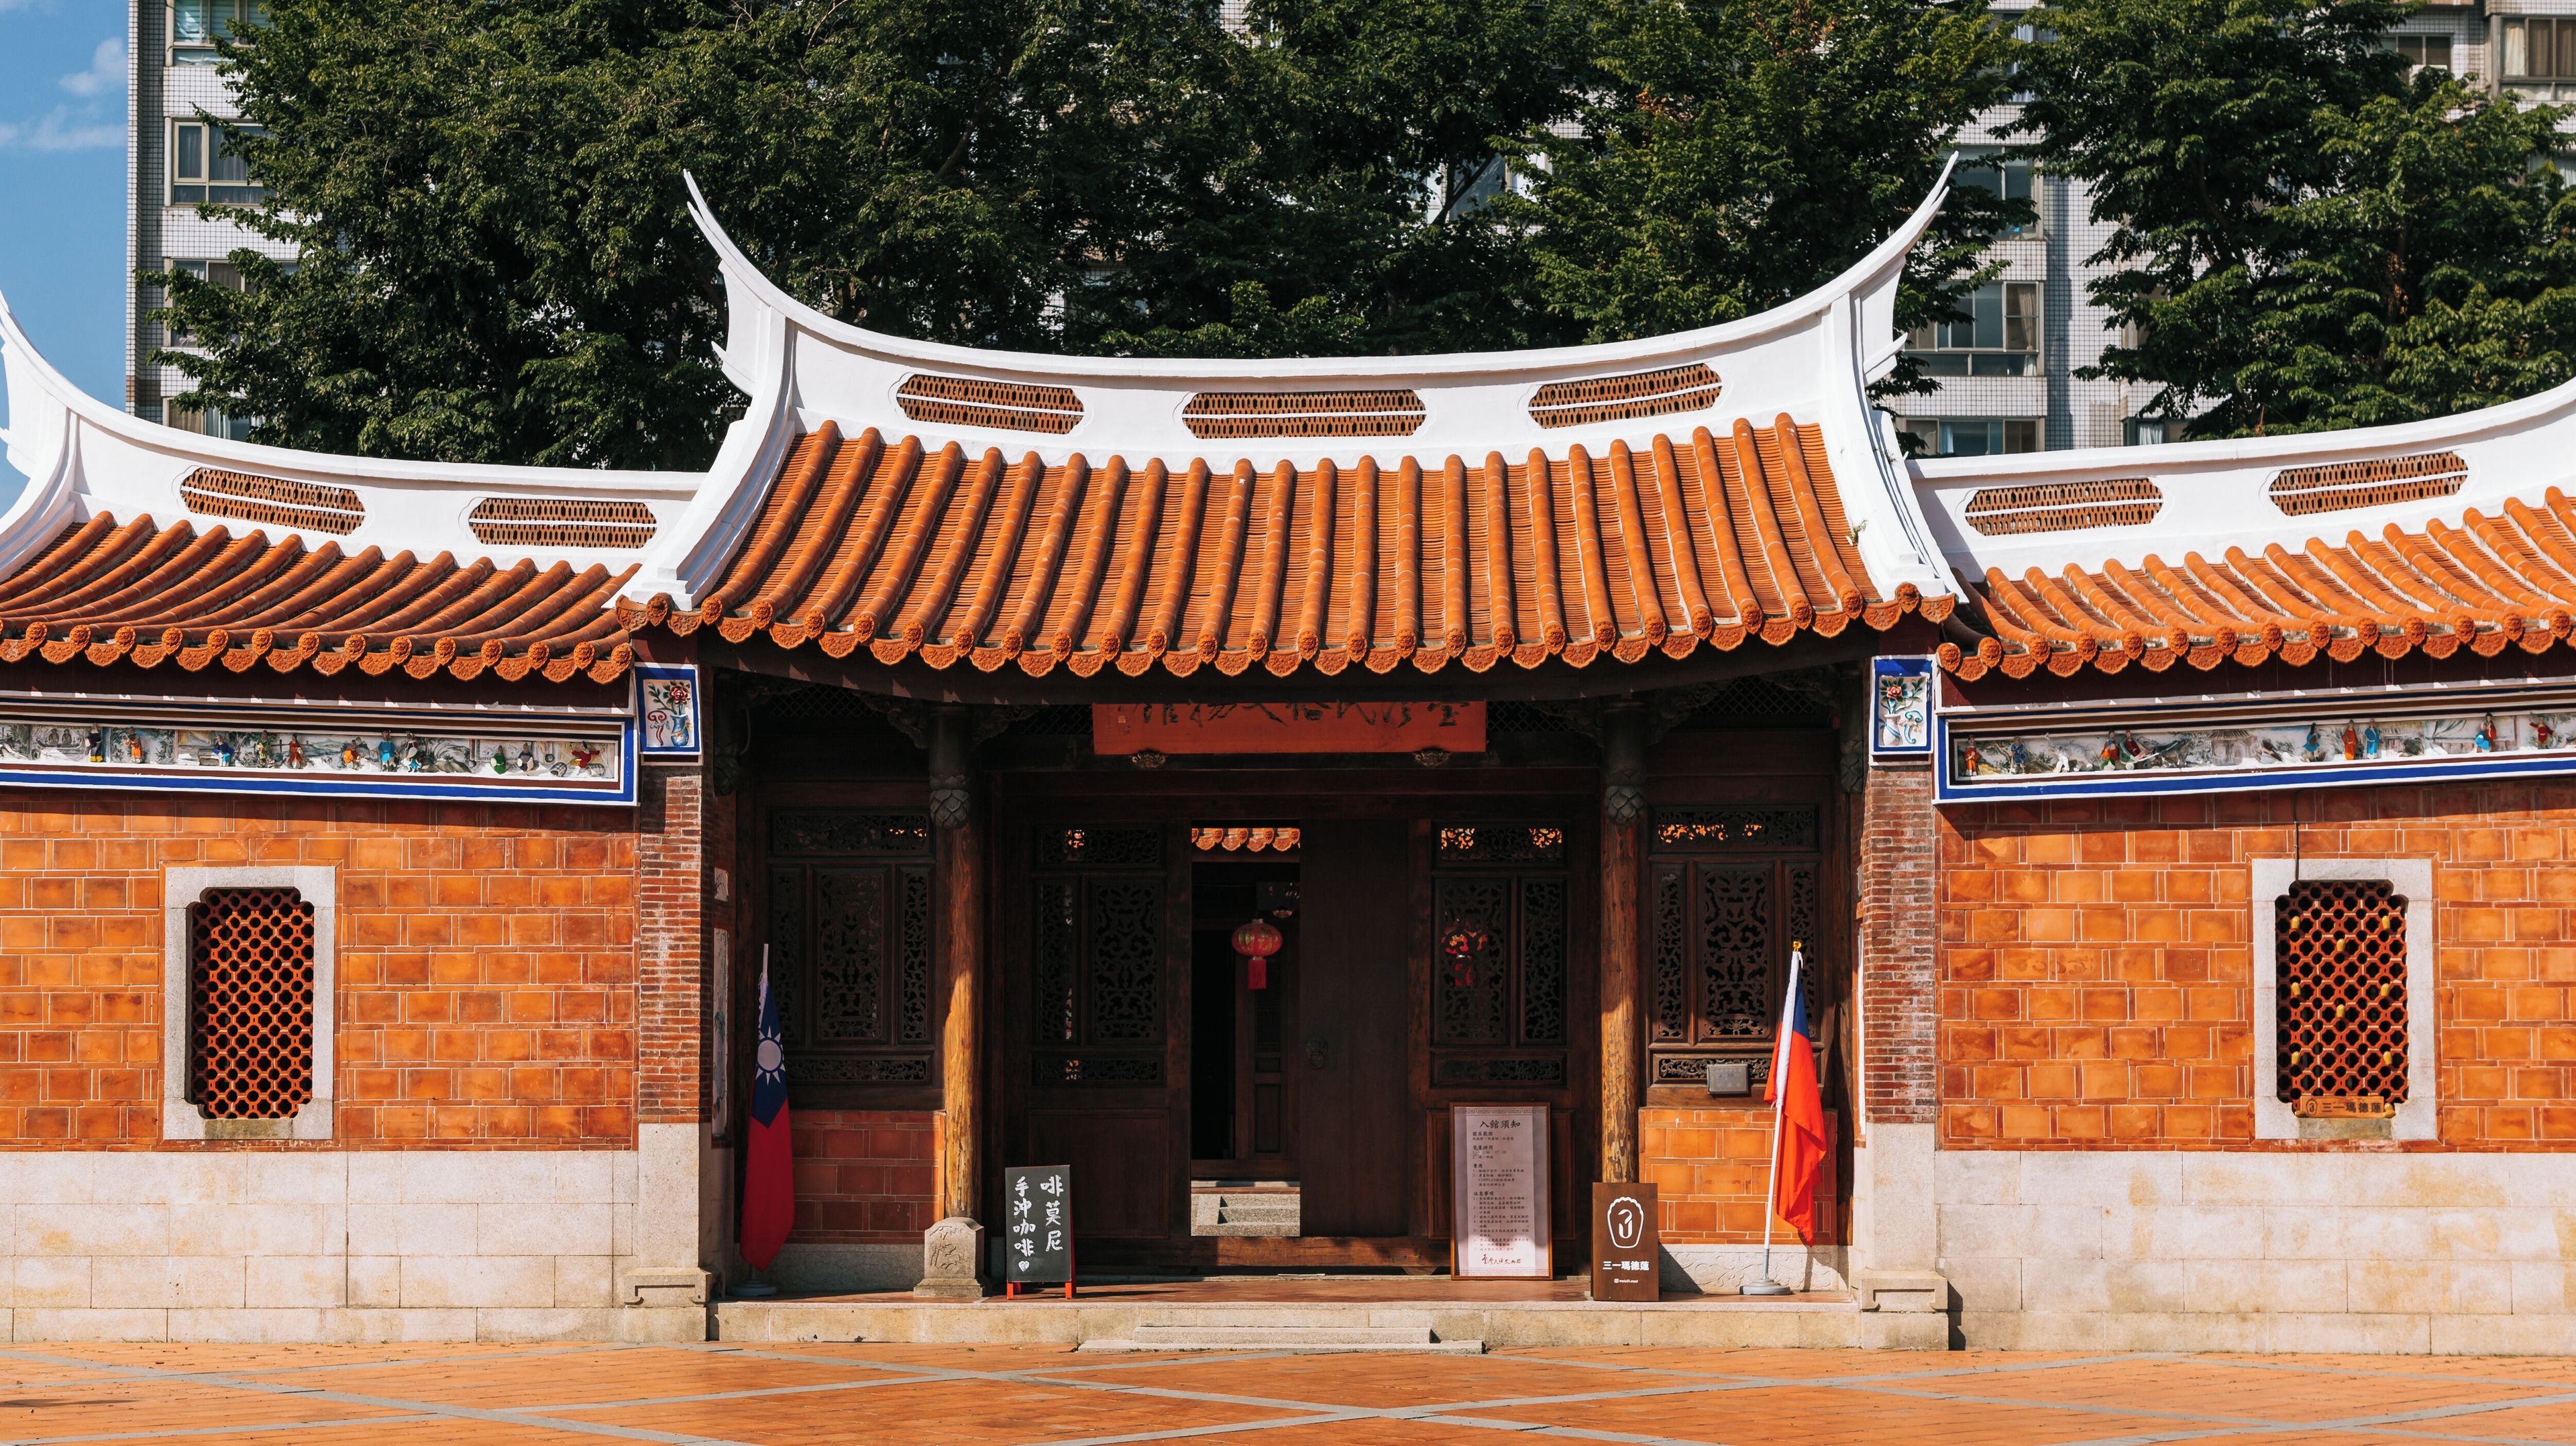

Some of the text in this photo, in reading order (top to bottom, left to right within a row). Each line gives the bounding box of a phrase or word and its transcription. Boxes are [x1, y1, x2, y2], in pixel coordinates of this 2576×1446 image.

[1480, 1119, 1521, 1129] 入館須知
[1013, 1176, 1036, 1257] 手沖咖啡
[1040, 1174, 1064, 1252] 啡莫尼
[1603, 1261, 1650, 1271] 三一瑪德蓮
